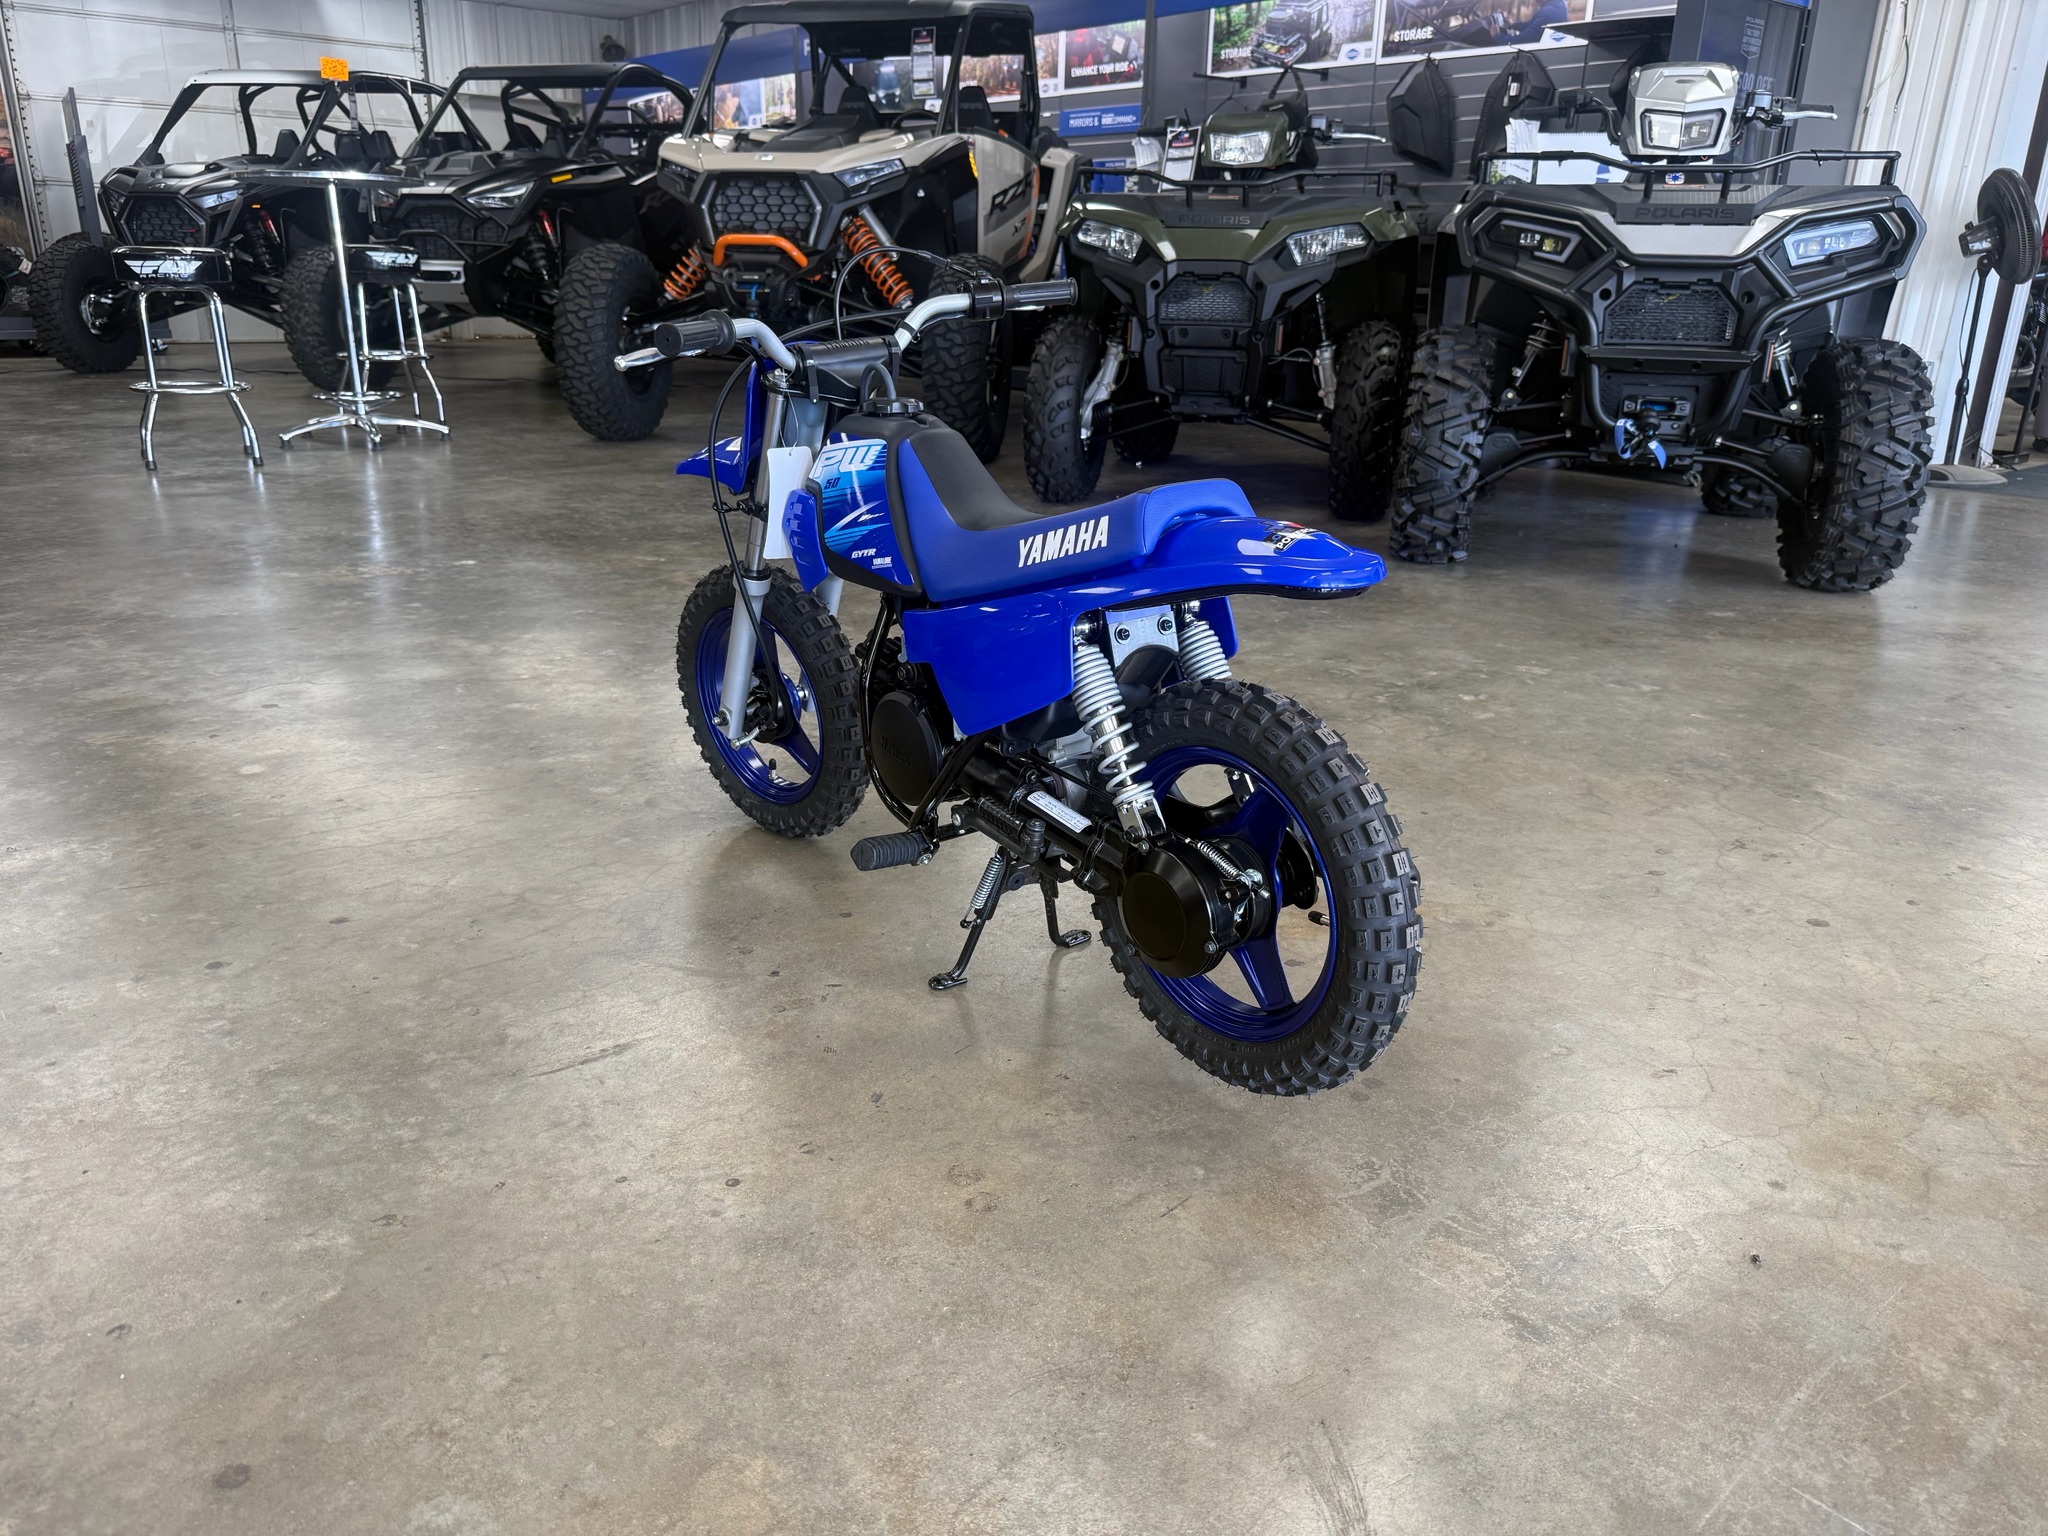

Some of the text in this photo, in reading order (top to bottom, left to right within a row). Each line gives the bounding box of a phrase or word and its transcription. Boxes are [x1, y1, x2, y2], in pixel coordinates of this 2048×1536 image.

[1393, 26, 1434, 42] STORAGE
[1220, 46, 1253, 59] STORAGE
[1070, 61, 1130, 78] ENHANCE YOUR RIDE
[1069, 117, 1094, 129] MIRRORS
[1094, 116, 1100, 127] &
[1178, 214, 1251, 225] POLARIS
[1635, 207, 1735, 219] POLARIS
[823, 476, 842, 490] 50
[1018, 515, 1109, 568] YAMAHA
[851, 547, 877, 560] GYTR
